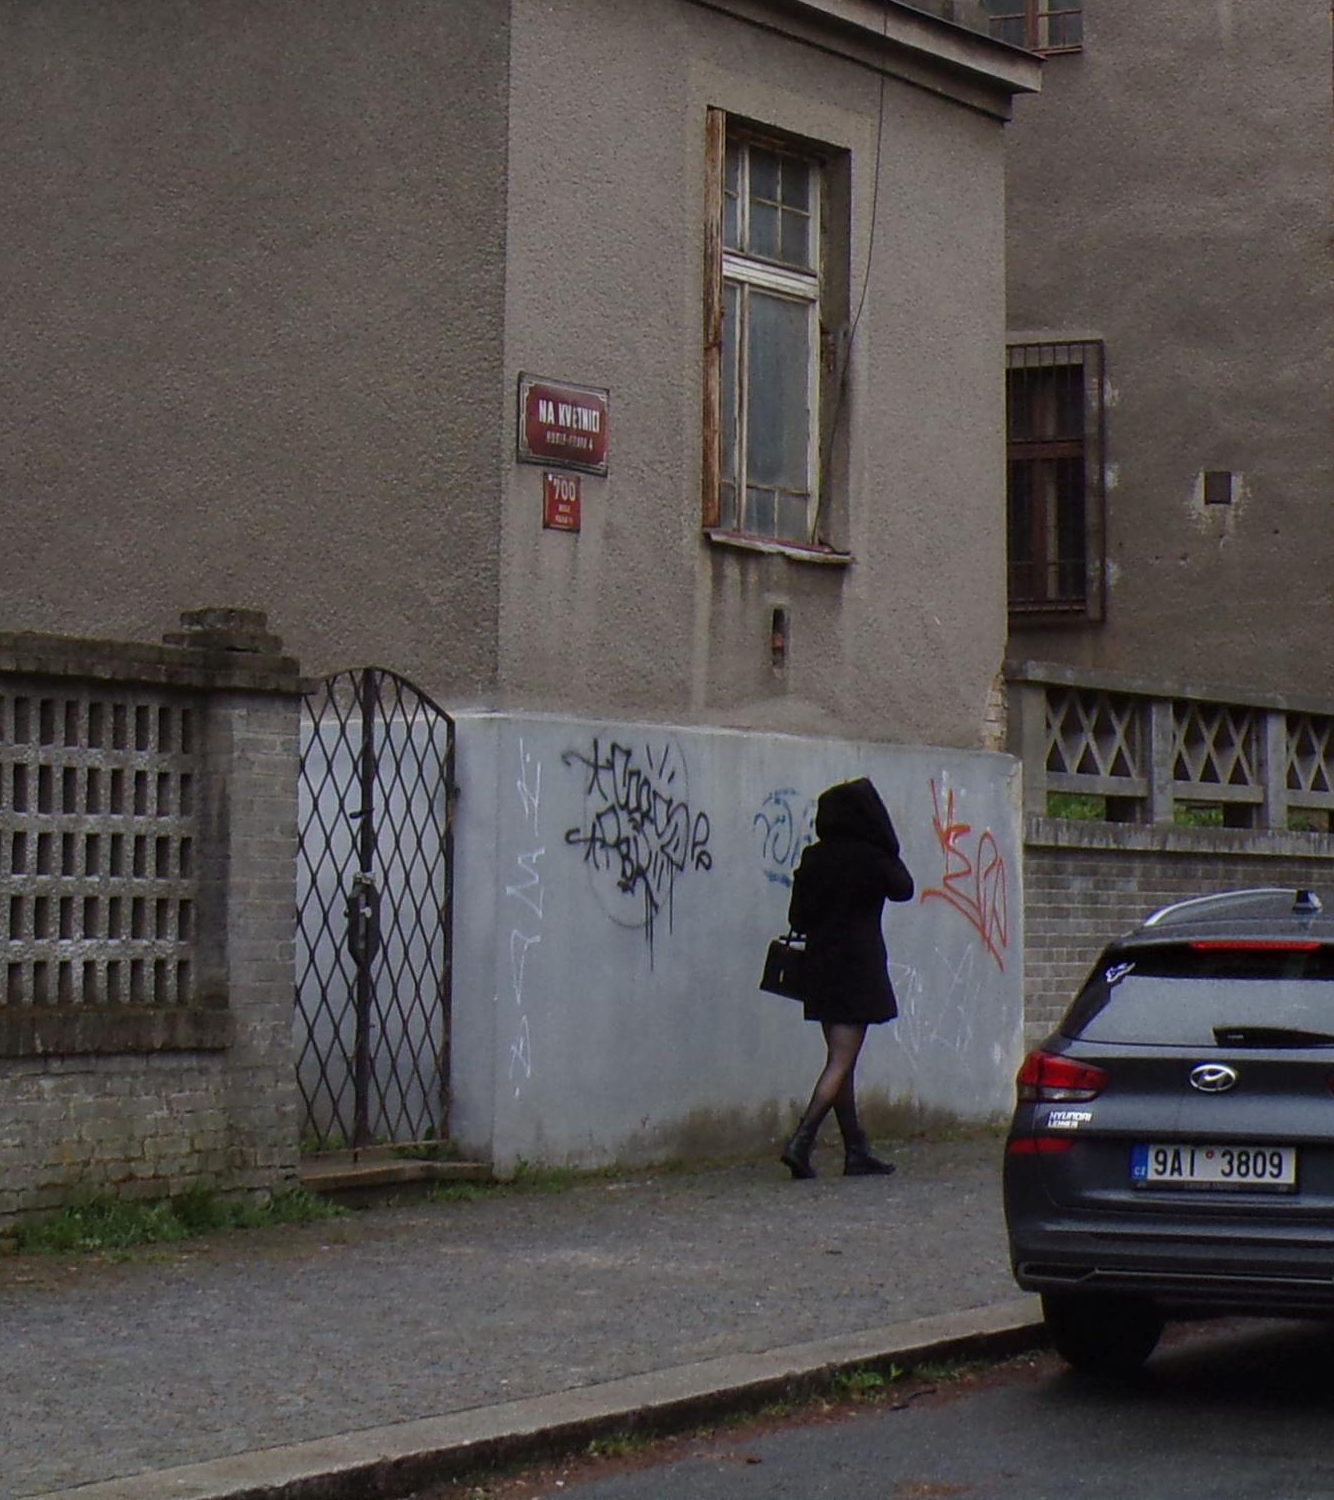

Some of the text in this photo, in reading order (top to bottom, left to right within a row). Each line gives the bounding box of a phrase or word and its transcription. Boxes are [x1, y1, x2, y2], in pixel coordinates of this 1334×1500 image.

[538, 398, 555, 425] NA
[553, 477, 576, 502] 700
[1154, 1148, 1284, 1180] 9AI 3809
